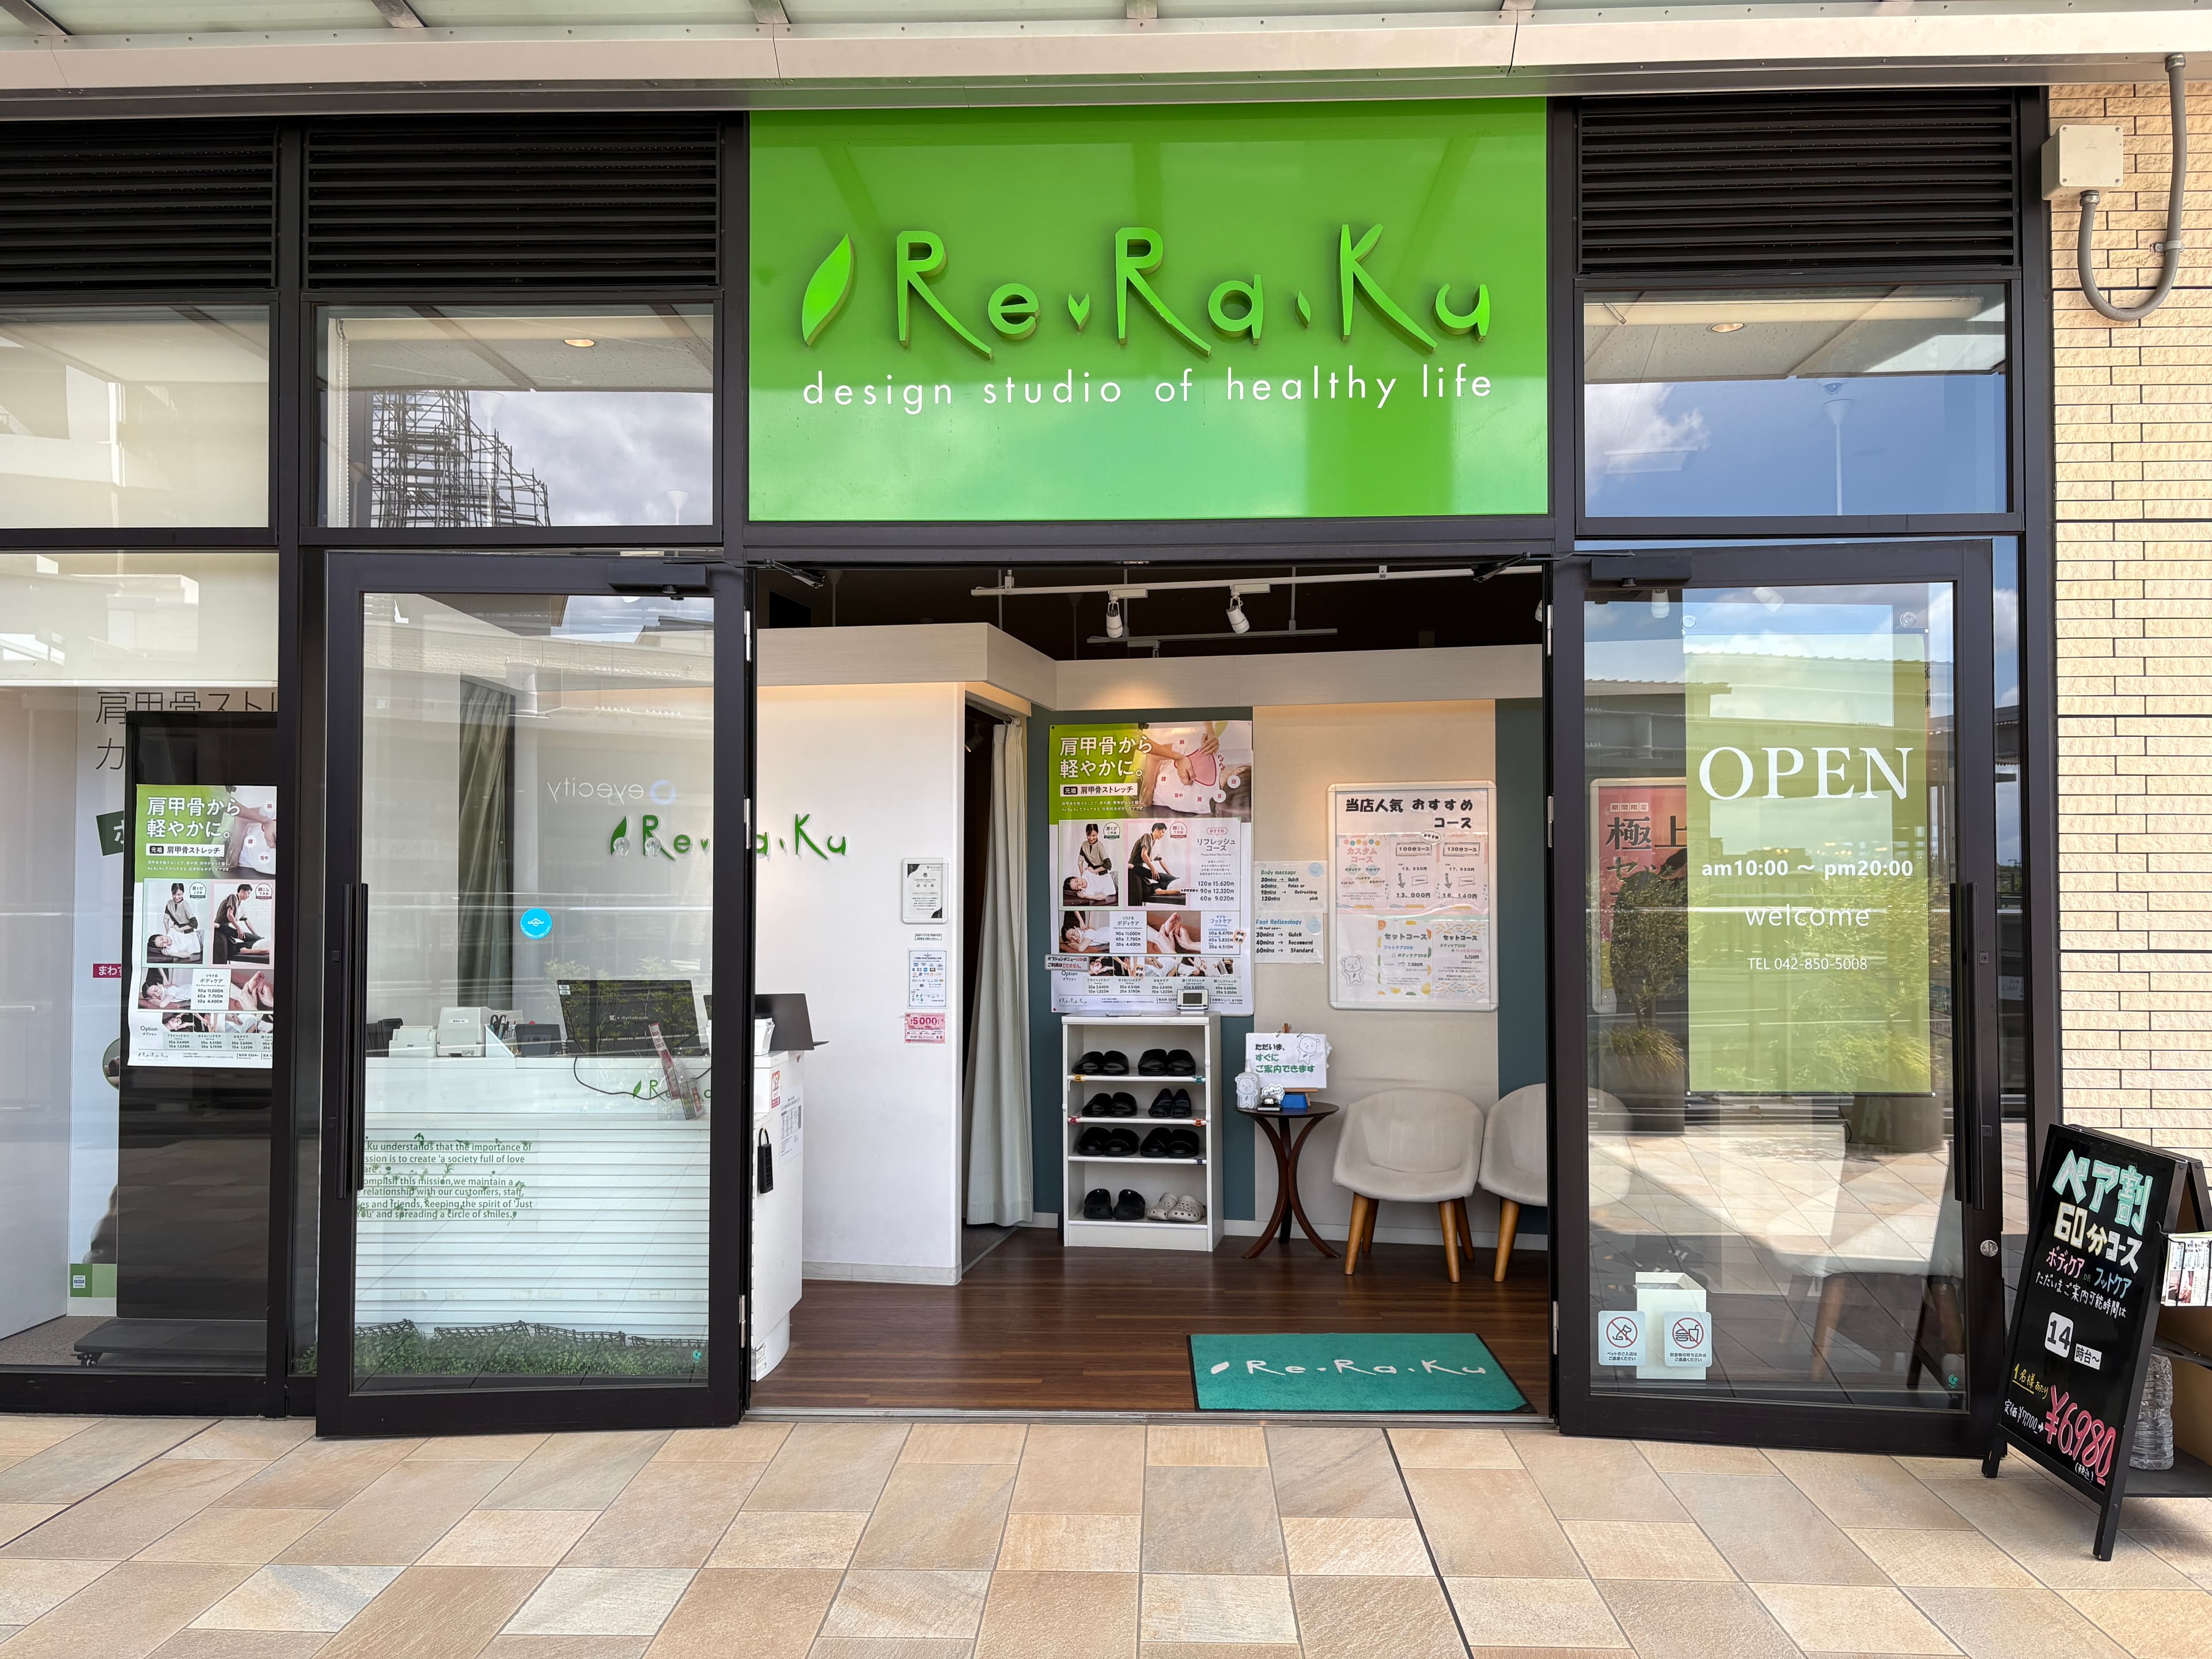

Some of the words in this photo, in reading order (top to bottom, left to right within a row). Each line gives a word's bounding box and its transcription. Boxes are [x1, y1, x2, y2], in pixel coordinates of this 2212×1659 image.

[803, 370, 952, 415] design
[984, 369, 1121, 404] studio
[1154, 369, 1192, 402] of
[1228, 365, 1396, 408] healthy
[1423, 363, 1491, 398] life
[1059, 736, 1152, 756] 肩甲骨から
[1060, 759, 1142, 778] 軽やかに。
[1699, 747, 1914, 800] OPEN
[1081, 786, 1133, 794] 肩甲骨ストレッチ
[147, 797, 240, 816] 肩甲骨から
[1346, 798, 1404, 813] 当店人気
[1412, 798, 1473, 811] おすすめ
[147, 819, 230, 838] 軽やかに。
[1434, 817, 1472, 829] コース
[1605, 816, 1687, 850] 極上
[1702, 859, 1788, 876] am10:00
[1824, 860, 1914, 880] pm20:00
[1745, 904, 1869, 927] welcome
[1747, 958, 1770, 969] TEL
[1774, 958, 1867, 970] 042-850-5008
[1255, 1065, 1315, 1073] ご案内できます
[381, 1142, 433, 1150] understands
[456, 1142, 469, 1151] the
[472, 1143, 520, 1152] importance
[523, 1143, 532, 1151] of
[448, 1155, 478, 1164] society
[480, 1154, 494, 1162] full
[507, 1154, 525, 1162] love
[468, 1177, 506, 1185] maintain
[363, 1187, 414, 1196] relationship
[417, 1187, 435, 1195] with
[503, 1187, 524, 1197] staff,
[2052, 1149, 2153, 1236] ペア割
[372, 1200, 388, 1208] and
[425, 1200, 459, 1209] keeping
[462, 1199, 476, 1207] the
[479, 1200, 502, 1209] spirit
[395, 1210, 437, 1219] spreading
[448, 1210, 469, 1218] circle
[472, 1210, 481, 1218] of
[2054, 1202, 2142, 1274] 60分コース
[2046, 1246, 2085, 1278] ボディケア
[2083, 1274, 2091, 1282] OR
[2094, 1267, 2132, 1298] フットケア
[2035, 1271, 2127, 1319] ただいまご案内可能時間は
[2047, 1320, 2071, 1351] 14
